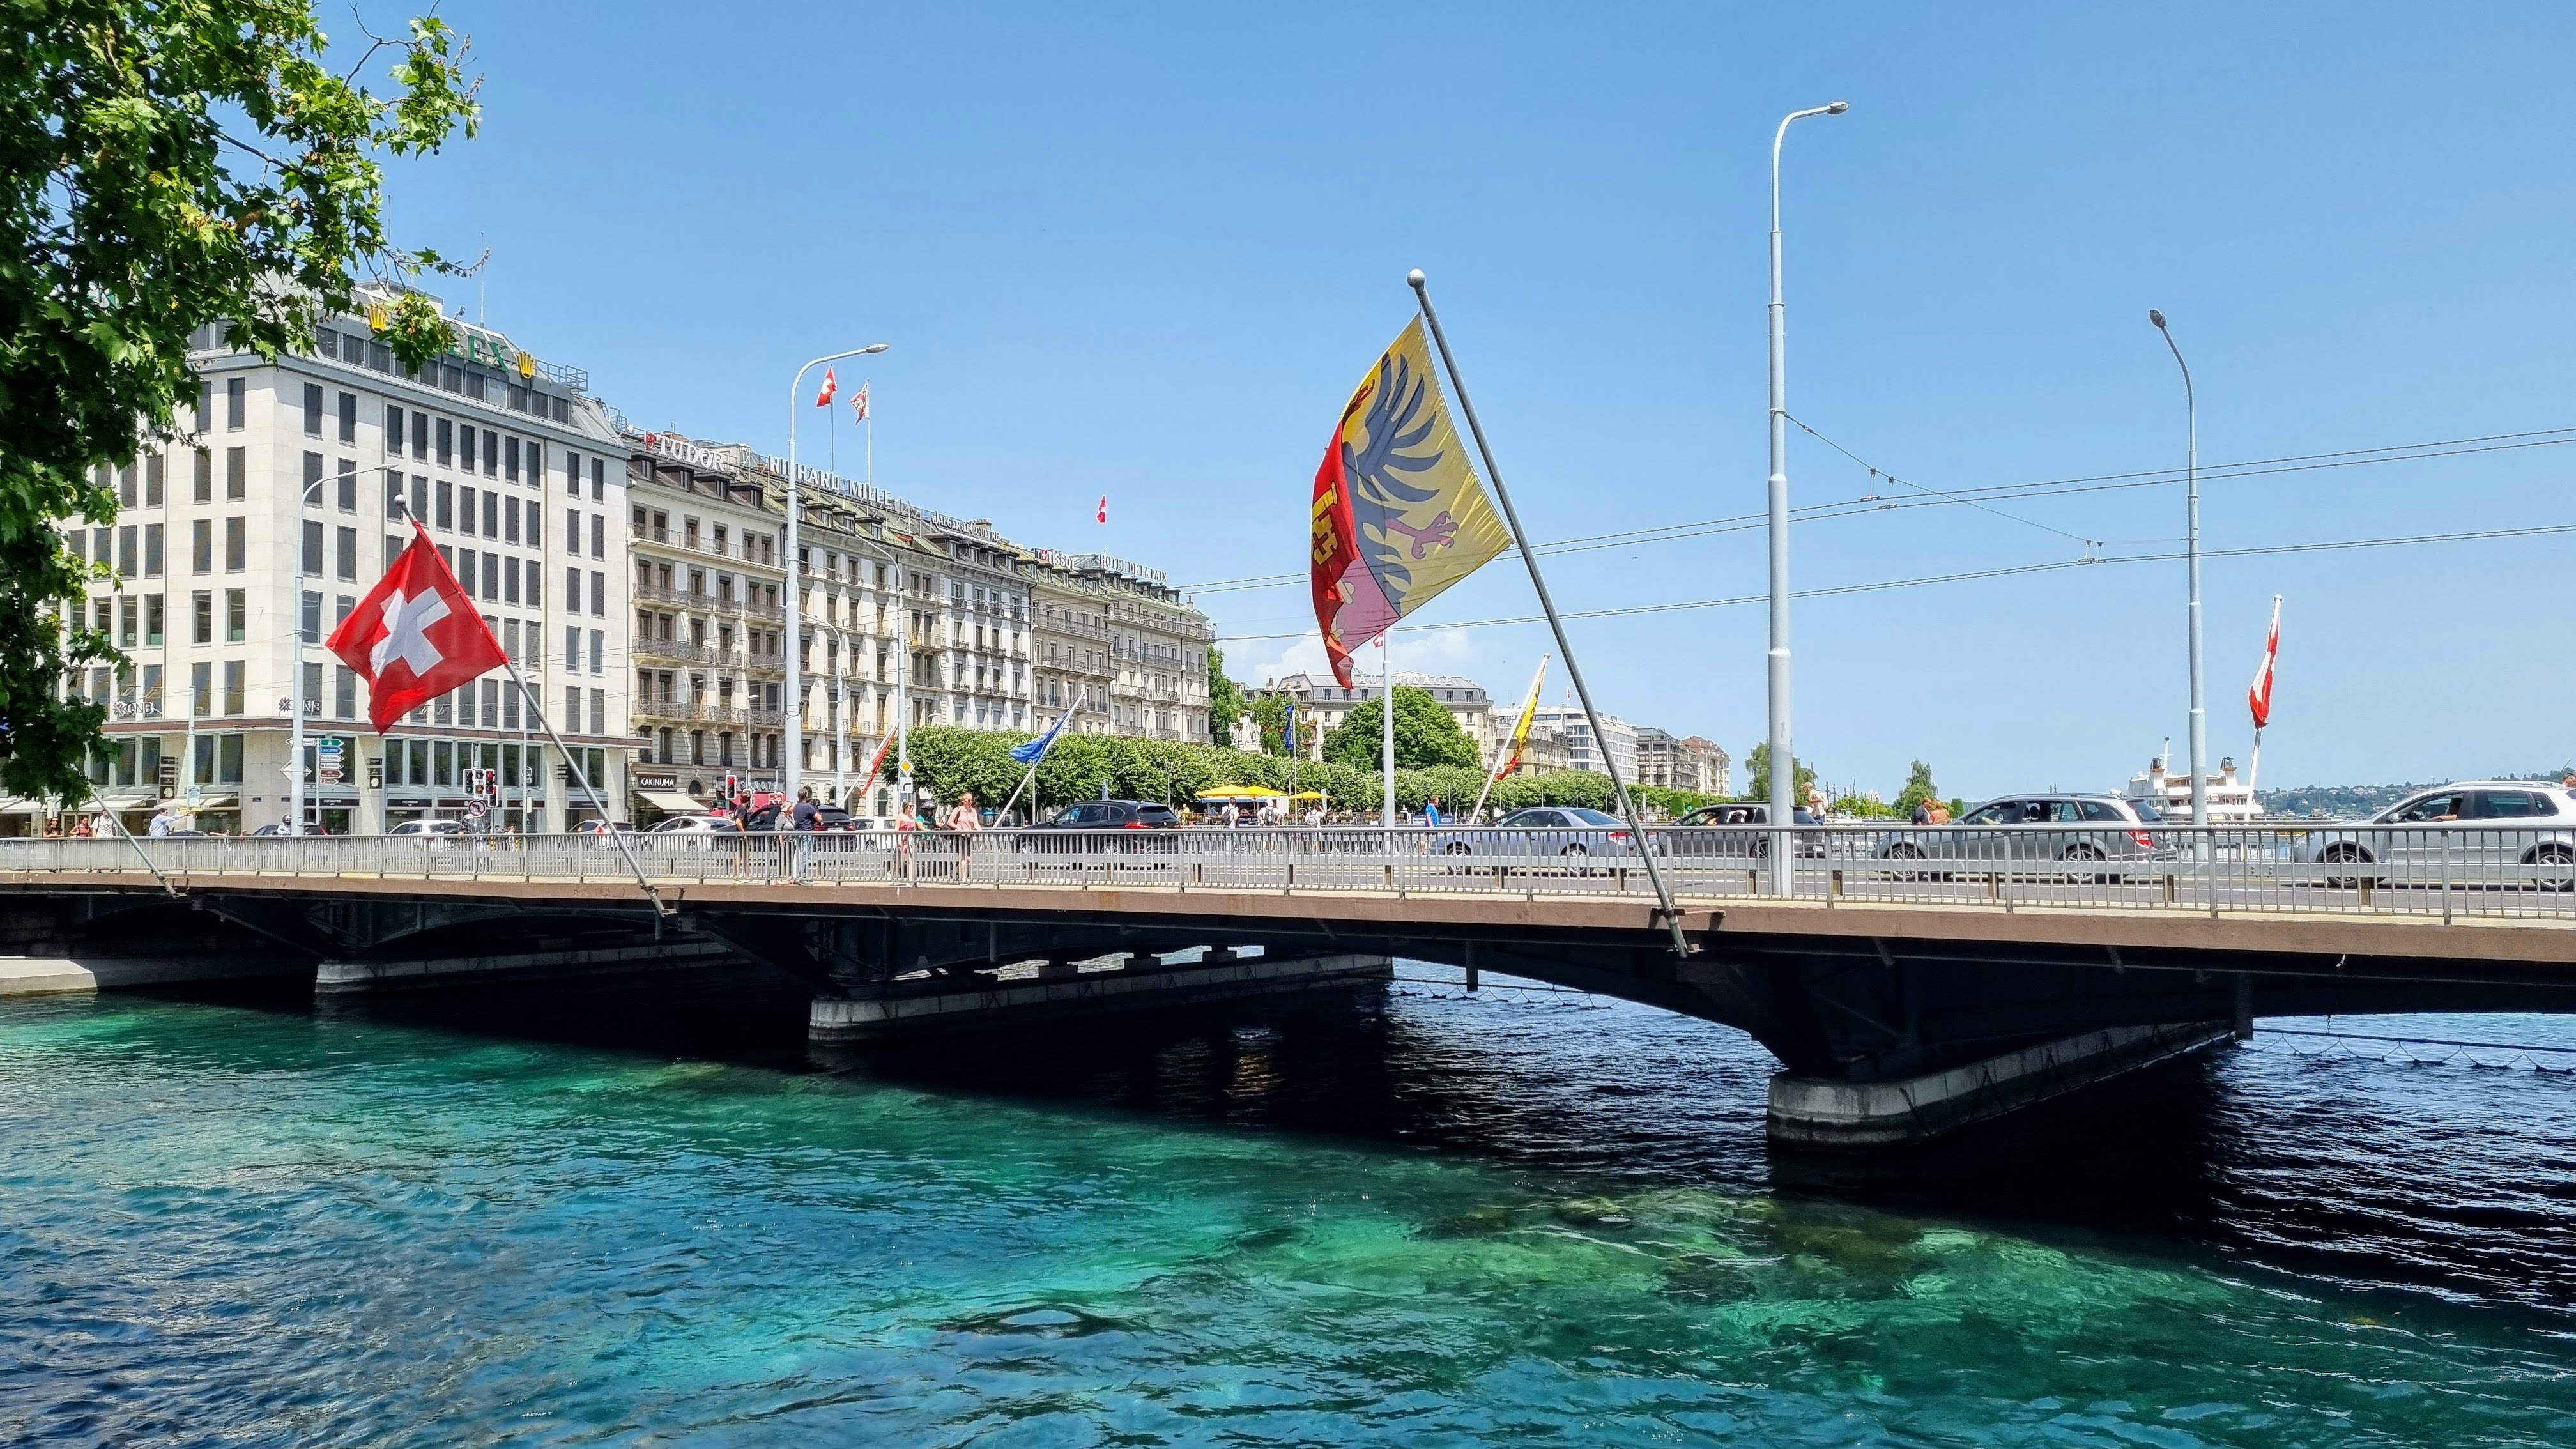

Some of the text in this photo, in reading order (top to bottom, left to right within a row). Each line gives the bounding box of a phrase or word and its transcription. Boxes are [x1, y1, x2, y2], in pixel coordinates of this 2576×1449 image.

[445, 329, 510, 373] LEX
[657, 434, 725, 472] TUDOR
[1046, 549, 1075, 569] TISSOT
[1128, 562, 1138, 574] DE
[1138, 565, 1149, 578] LA
[1149, 568, 1167, 582] PAIX
[1395, 675, 1453, 685] RIVAGE
[125, 702, 154, 715] QNB
[302, 700, 321, 712] NB
[640, 777, 675, 786] KAKINUMA
